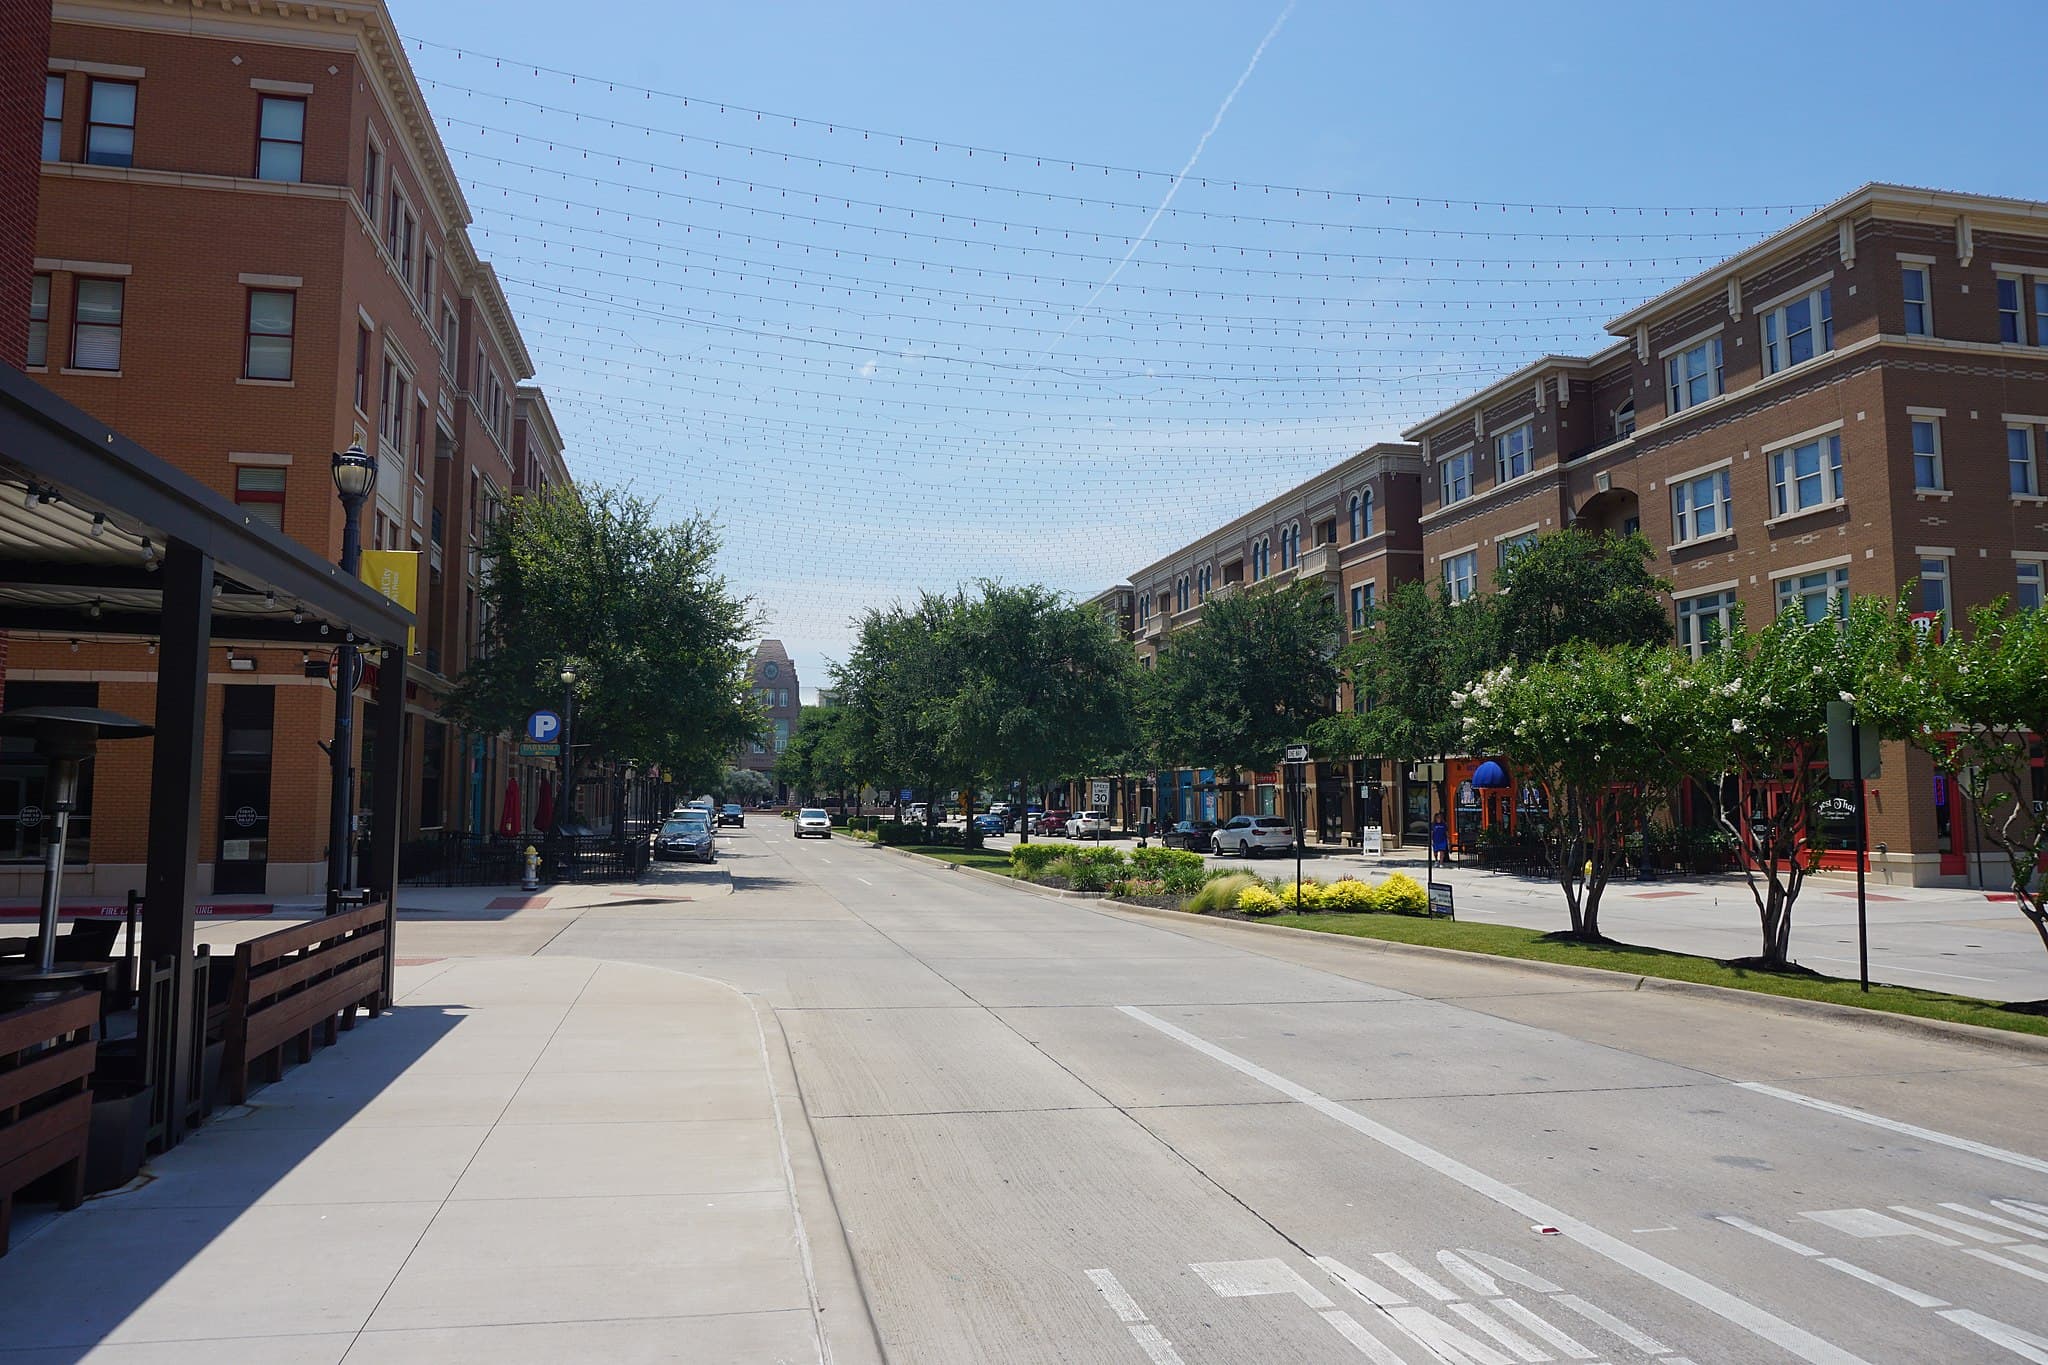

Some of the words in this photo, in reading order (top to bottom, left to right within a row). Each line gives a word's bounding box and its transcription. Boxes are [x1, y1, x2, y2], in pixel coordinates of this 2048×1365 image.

[536, 716, 556, 737] P
[1094, 794, 1107, 802] 30
[1834, 798, 1856, 813] Thai
[101, 907, 118, 915] FIRE
